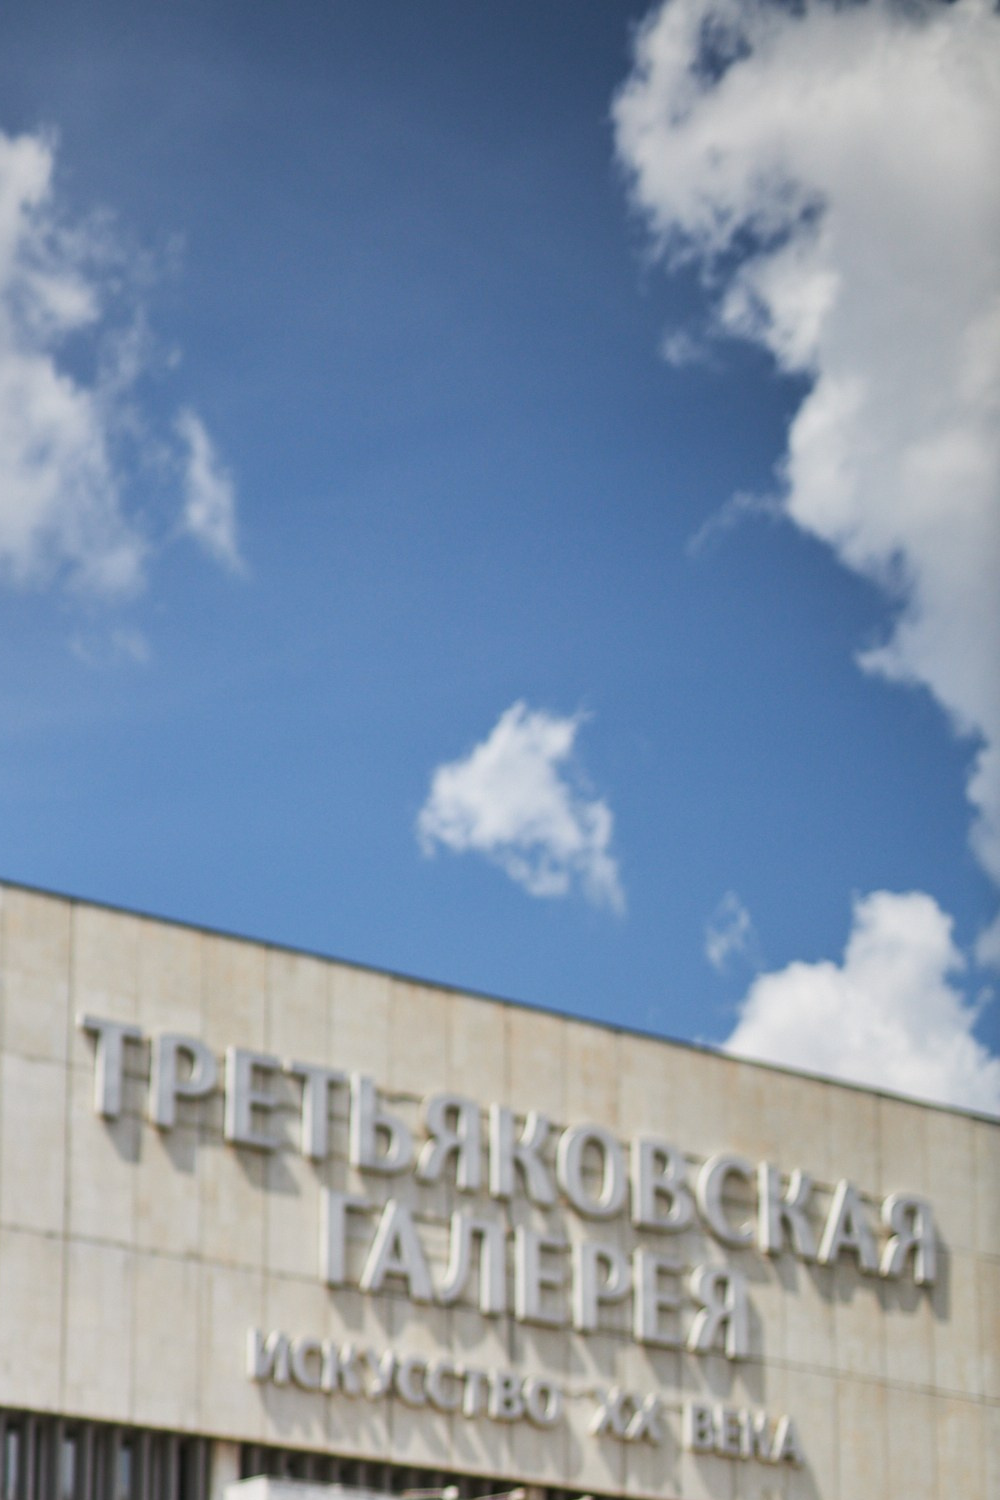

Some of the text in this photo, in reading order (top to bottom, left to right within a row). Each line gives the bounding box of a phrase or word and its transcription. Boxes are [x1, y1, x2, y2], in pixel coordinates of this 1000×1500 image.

[78, 1013, 938, 1287] ТРЕТЬЯКОВСКАЯ
[323, 1189, 750, 1361] ГАЛЕРЕЯ
[246, 1326, 563, 1429] ИСКУССТВО
